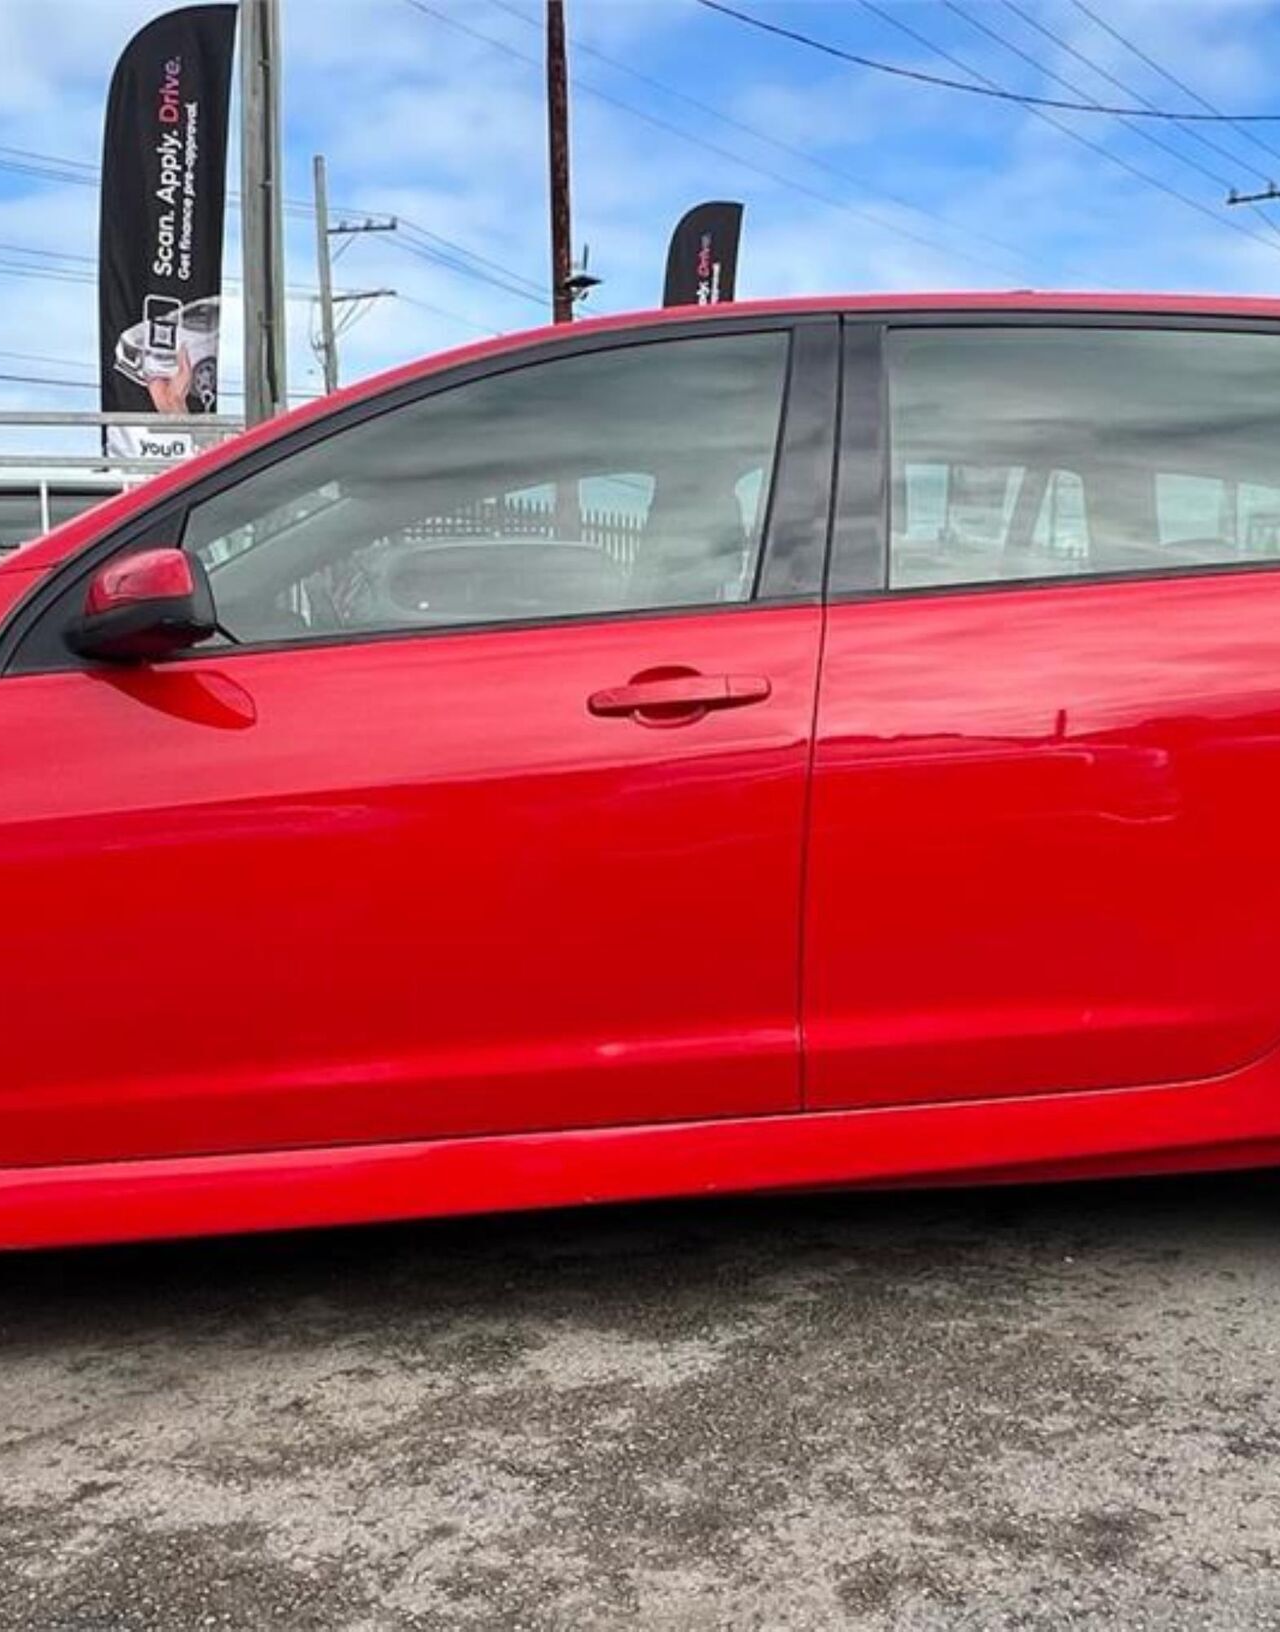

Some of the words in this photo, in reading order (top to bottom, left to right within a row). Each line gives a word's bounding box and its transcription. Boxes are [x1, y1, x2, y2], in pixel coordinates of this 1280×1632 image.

[159, 56, 180, 122] Drive.
[155, 129, 182, 205] Apply.
[153, 209, 175, 277] Scan.
[179, 197, 194, 250] finance
[178, 253, 191, 280] Get
